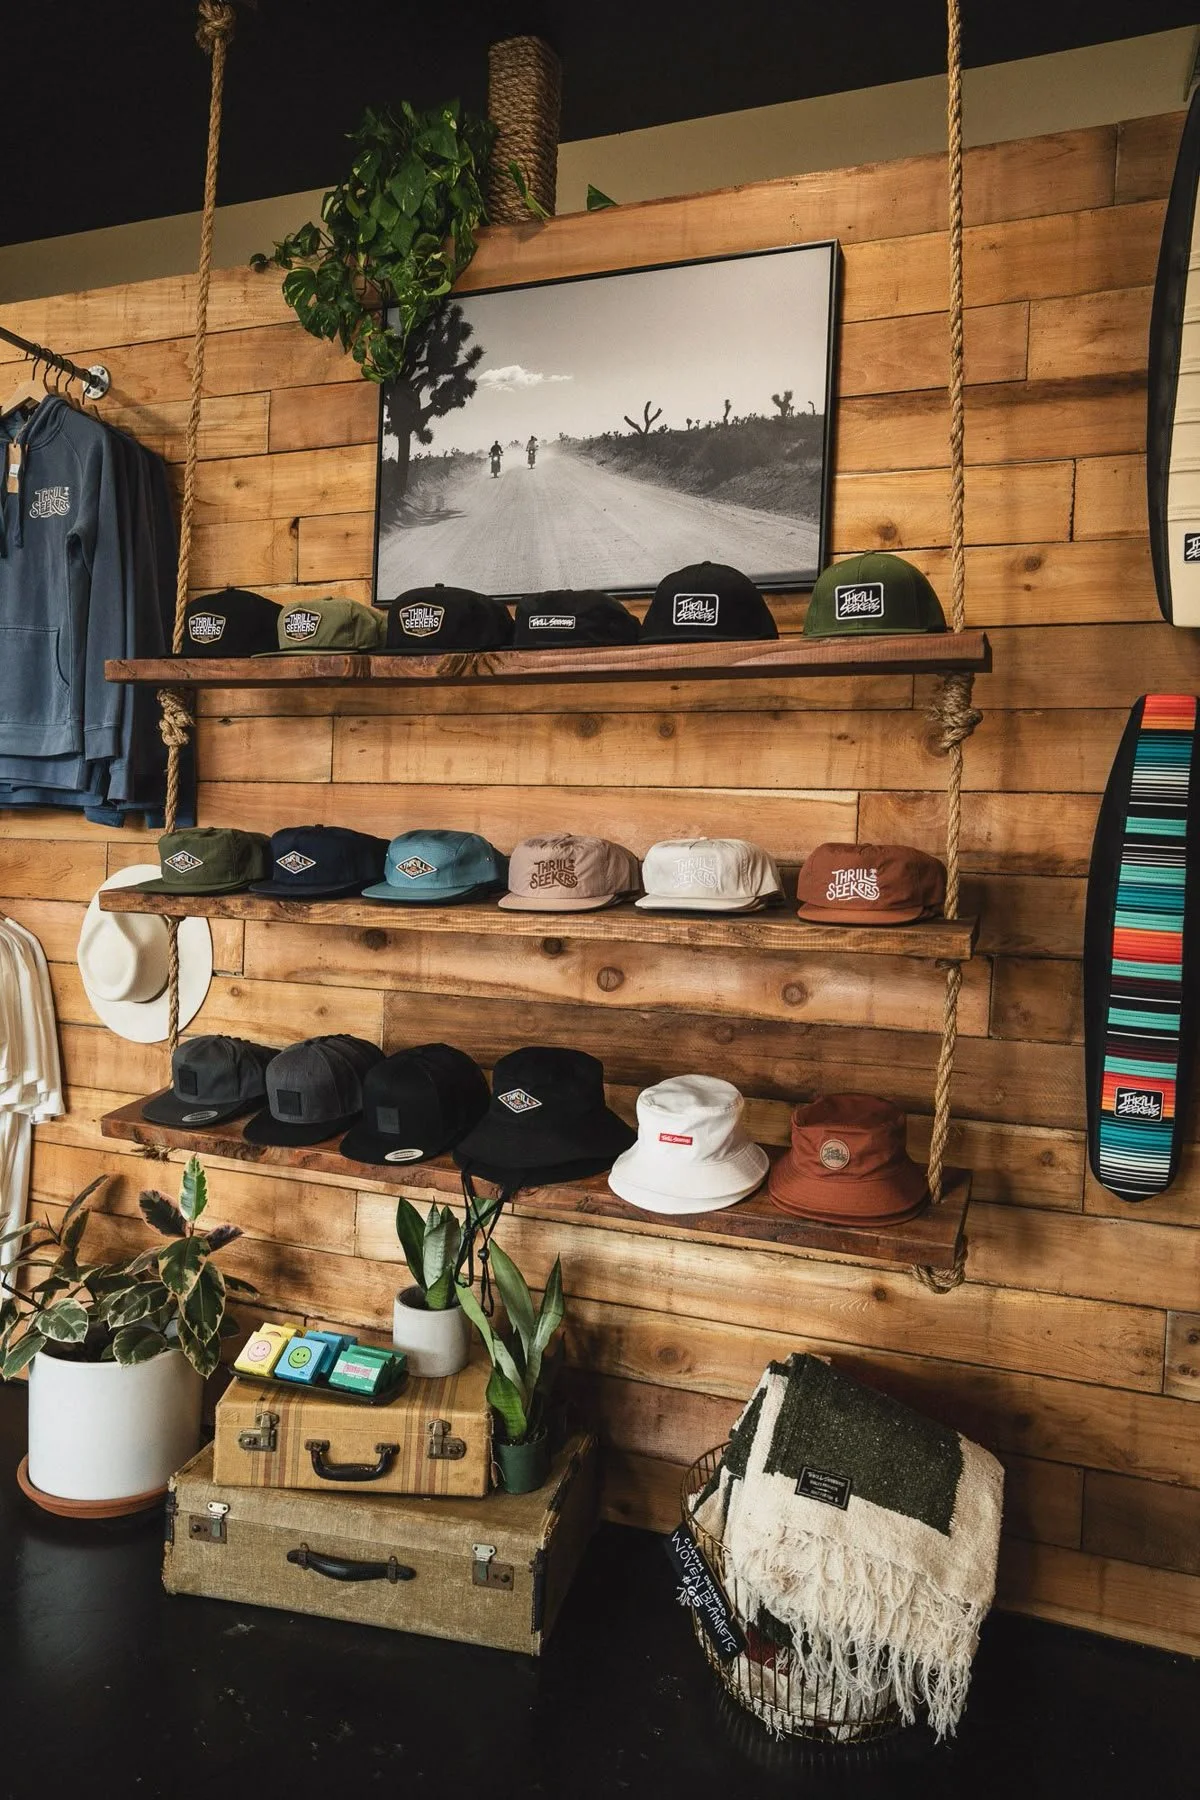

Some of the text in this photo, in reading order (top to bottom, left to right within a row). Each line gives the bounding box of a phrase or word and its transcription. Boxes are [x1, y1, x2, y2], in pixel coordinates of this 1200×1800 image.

[408, 607, 434, 620] THRILL
[192, 626, 222, 636] SEEKERS
[286, 622, 316, 633] SEEKERS
[405, 617, 439, 629] SEEKERS
[533, 859, 576, 875] THRILL
[529, 871, 579, 889] SEEKERS
[831, 868, 877, 886] THRILL
[826, 881, 880, 900] SEEKERS
[684, 1538, 705, 1572] CUSTOM
[671, 1531, 738, 1653] WOVEN BLANKETS
